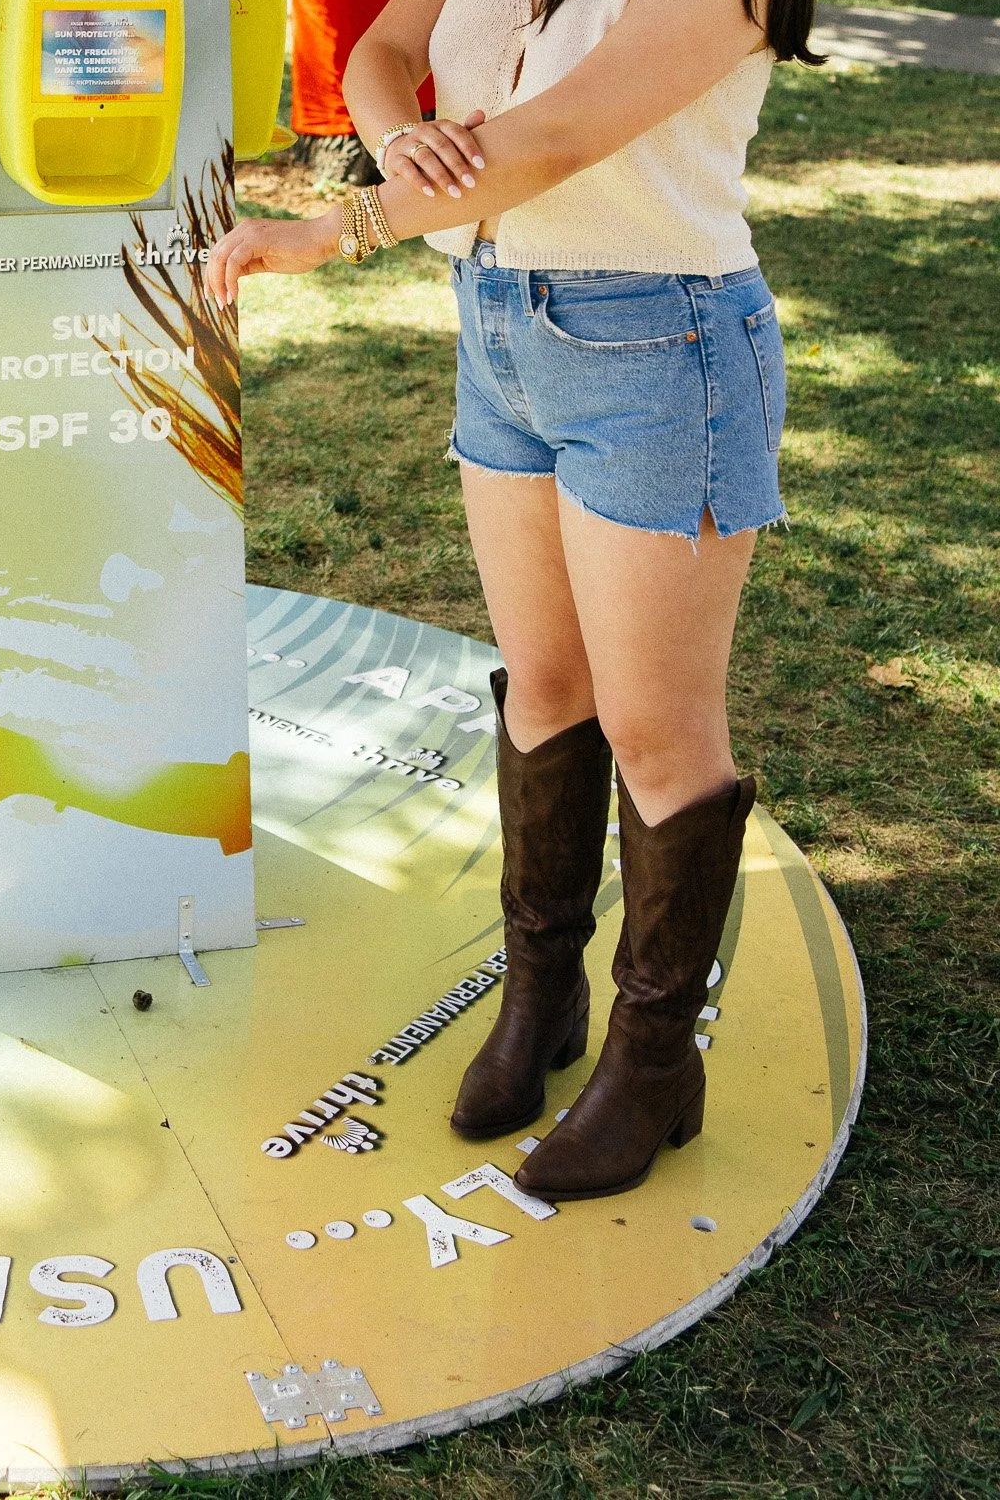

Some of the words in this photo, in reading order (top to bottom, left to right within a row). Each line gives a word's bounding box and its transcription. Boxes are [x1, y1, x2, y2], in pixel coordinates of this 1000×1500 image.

[55, 30, 73, 38] SUN
[55, 48, 82, 56] APPLY
[55, 57, 81, 65] WEAR
[54, 66, 84, 74] DANCE
[134, 243, 210, 266] thrive
[51, 312, 122, 341] SUN
[109, 406, 173, 445] 30
[350, 743, 463, 792] thrive
[260, 1071, 378, 1159] thrive
